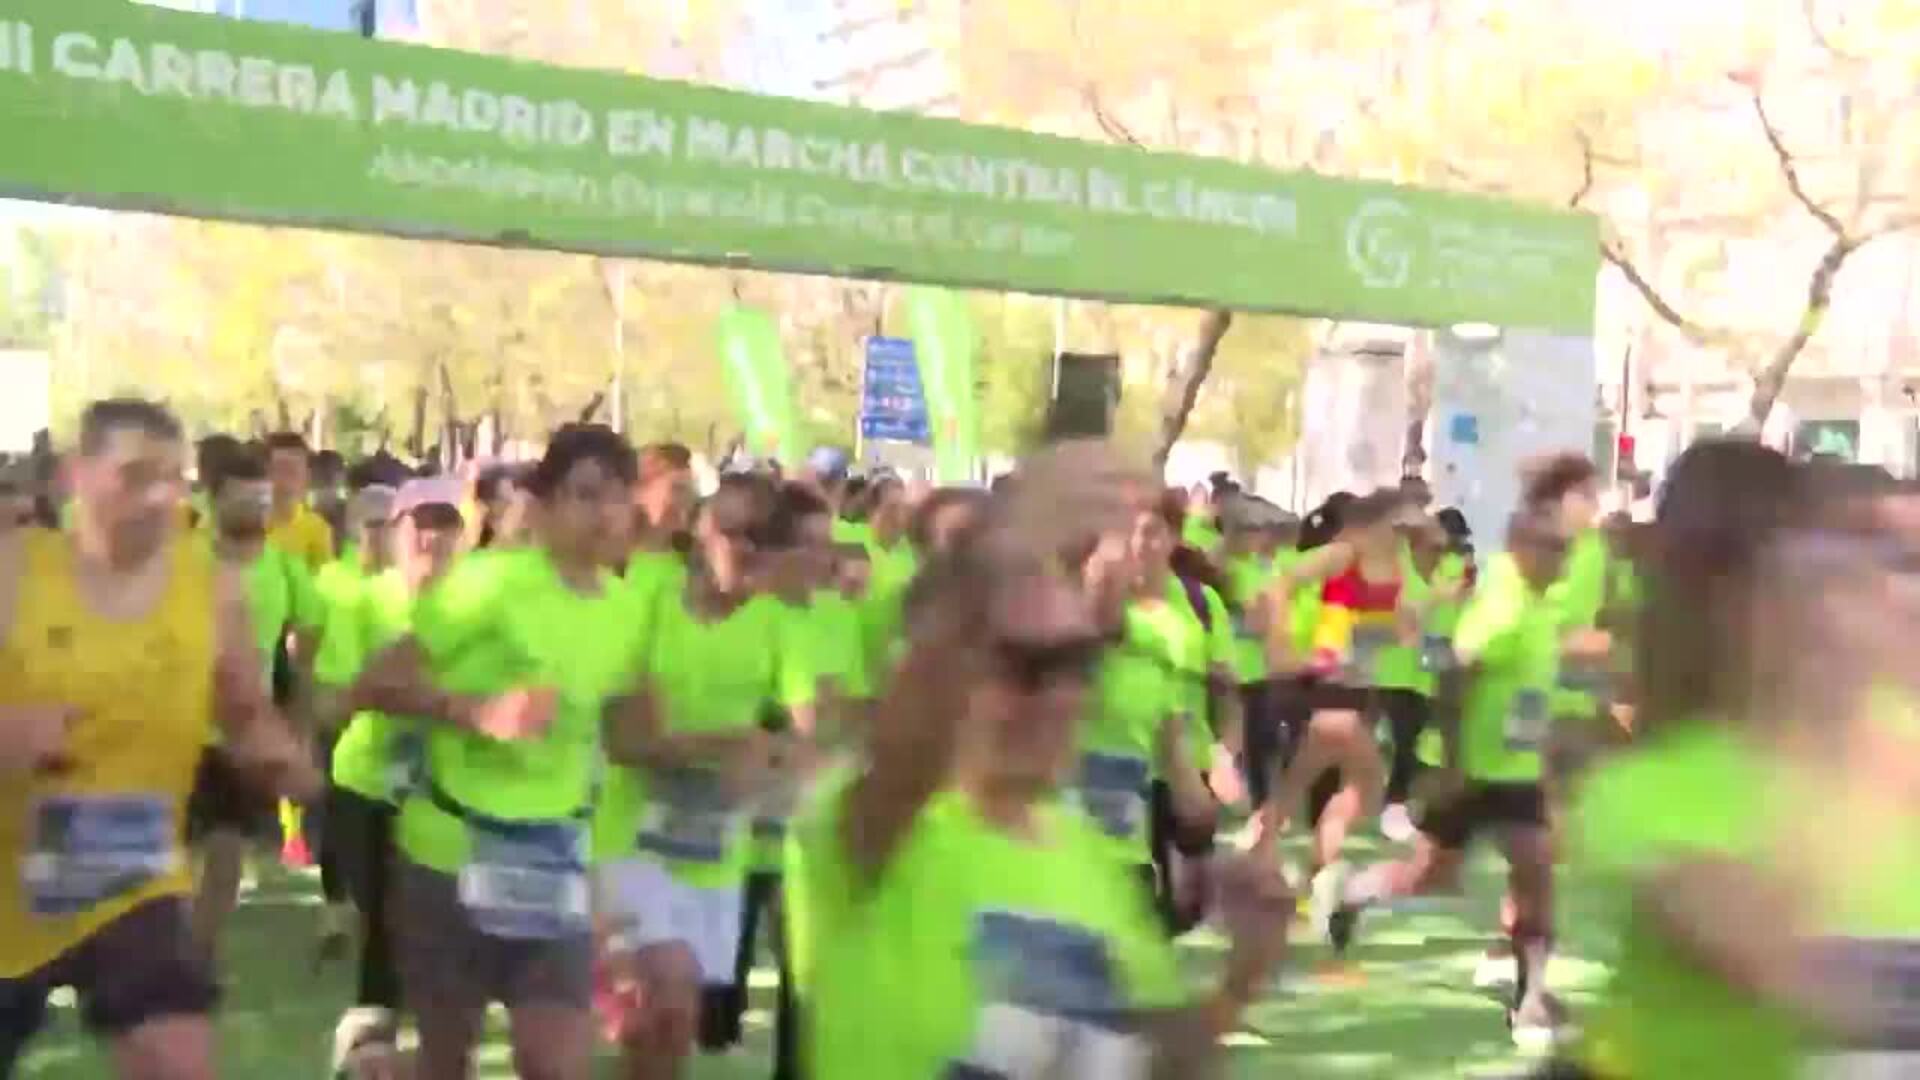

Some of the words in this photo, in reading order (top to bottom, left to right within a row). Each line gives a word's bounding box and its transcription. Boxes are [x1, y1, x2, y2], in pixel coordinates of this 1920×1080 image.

[52, 32, 356, 121] CARRERA
[372, 73, 594, 146] MADRID
[607, 108, 675, 155] EN
